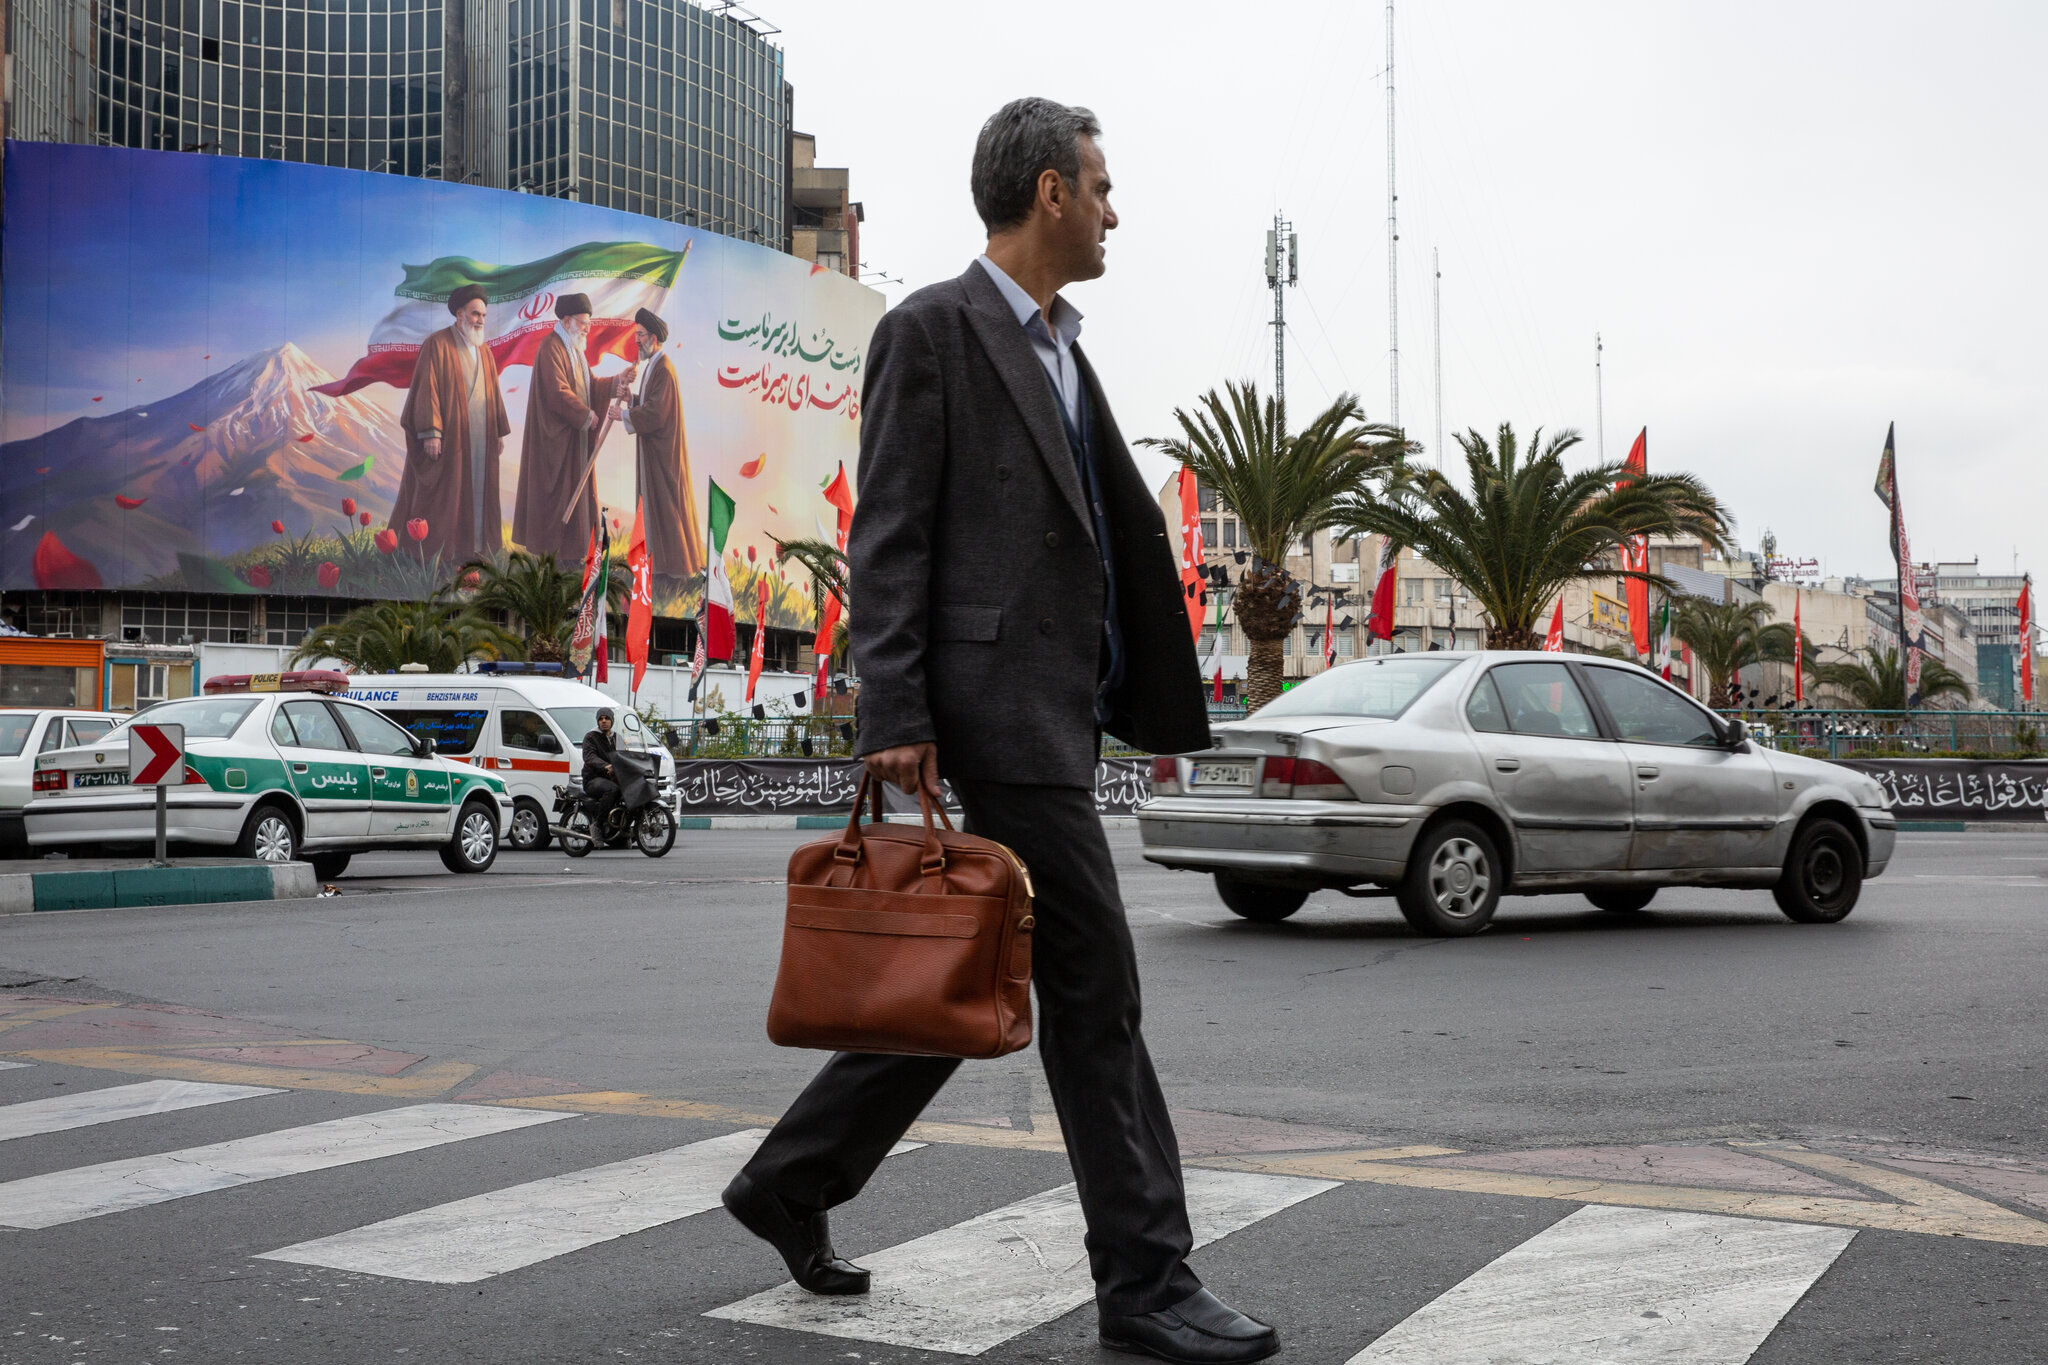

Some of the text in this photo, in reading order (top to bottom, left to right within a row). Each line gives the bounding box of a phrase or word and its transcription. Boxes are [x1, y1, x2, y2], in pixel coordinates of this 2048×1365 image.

[717, 362, 771, 394] ماست
[761, 372, 788, 404] رهبر
[1796, 556, 1818, 569] هتل
[253, 674, 278, 683] POLICE
[331, 691, 400, 701] BULANCE
[426, 692, 478, 701] BEHZISTAN PARS
[312, 771, 358, 793] پلیس
